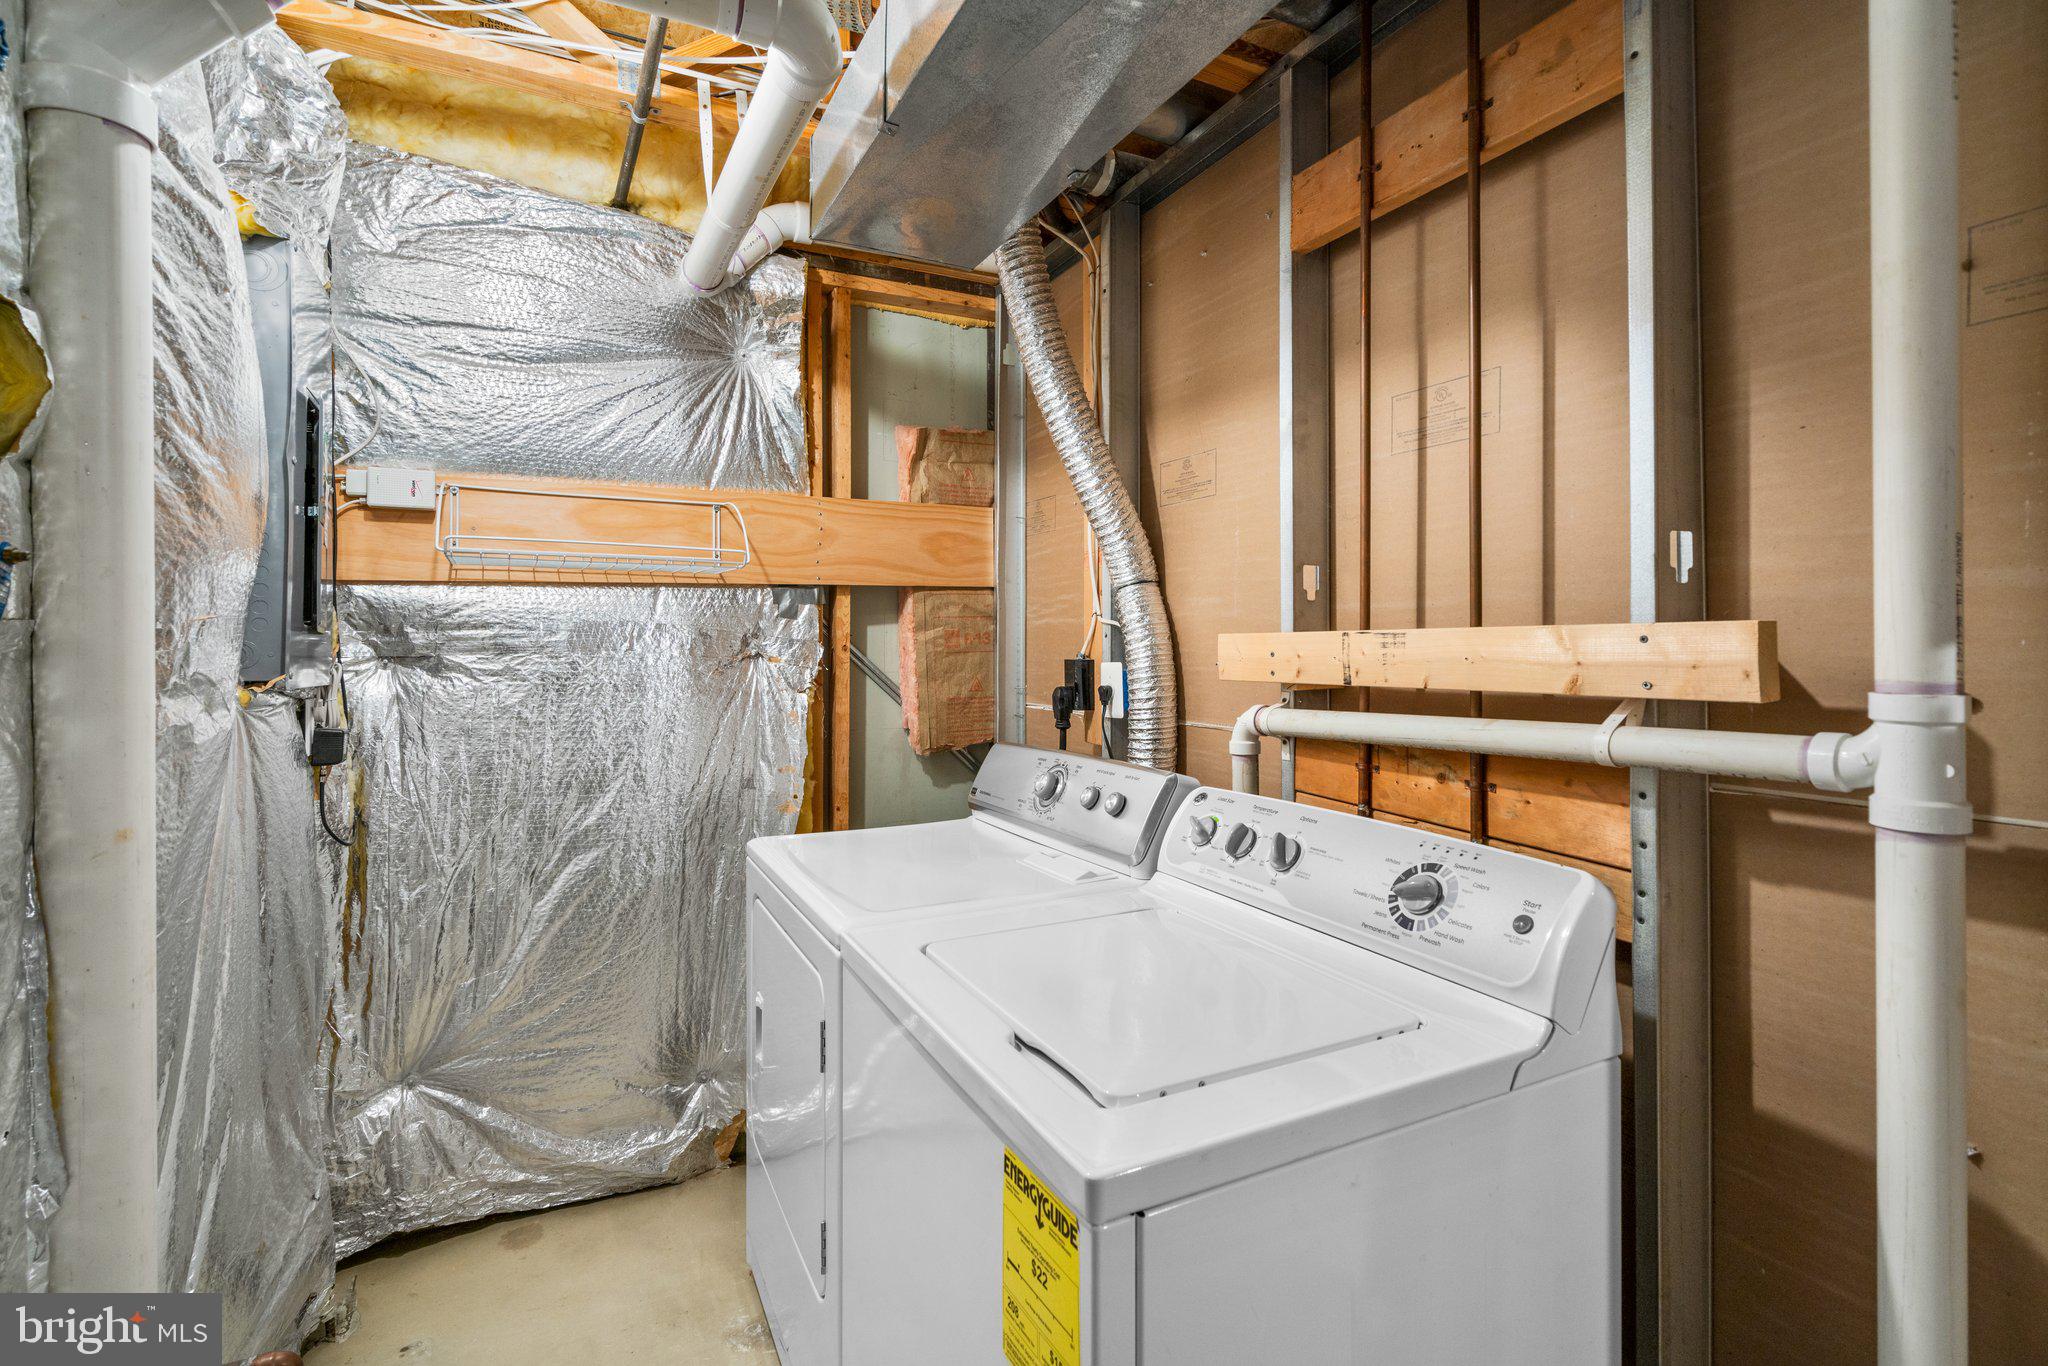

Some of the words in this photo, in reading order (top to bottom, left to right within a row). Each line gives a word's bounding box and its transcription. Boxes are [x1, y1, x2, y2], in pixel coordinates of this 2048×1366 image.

[1253, 804, 1278, 814] Temperature
[1300, 815, 1318, 824] Options
[1453, 863, 1469, 872] Speed
[1470, 867, 1486, 875] Wash
[1473, 882, 1490, 891] Colors
[1523, 900, 1542, 910] Start
[1448, 919, 1473, 930] Delicates
[1361, 922, 1386, 935] Permanent
[1386, 931, 1400, 940] Press
[1434, 930, 1449, 939] Hand
[1449, 934, 1465, 944] Wash
[1419, 935, 1442, 947] Prewash
[1004, 1155, 1079, 1251] ENERGYGUIDE
[1032, 1258, 1048, 1290] $22
